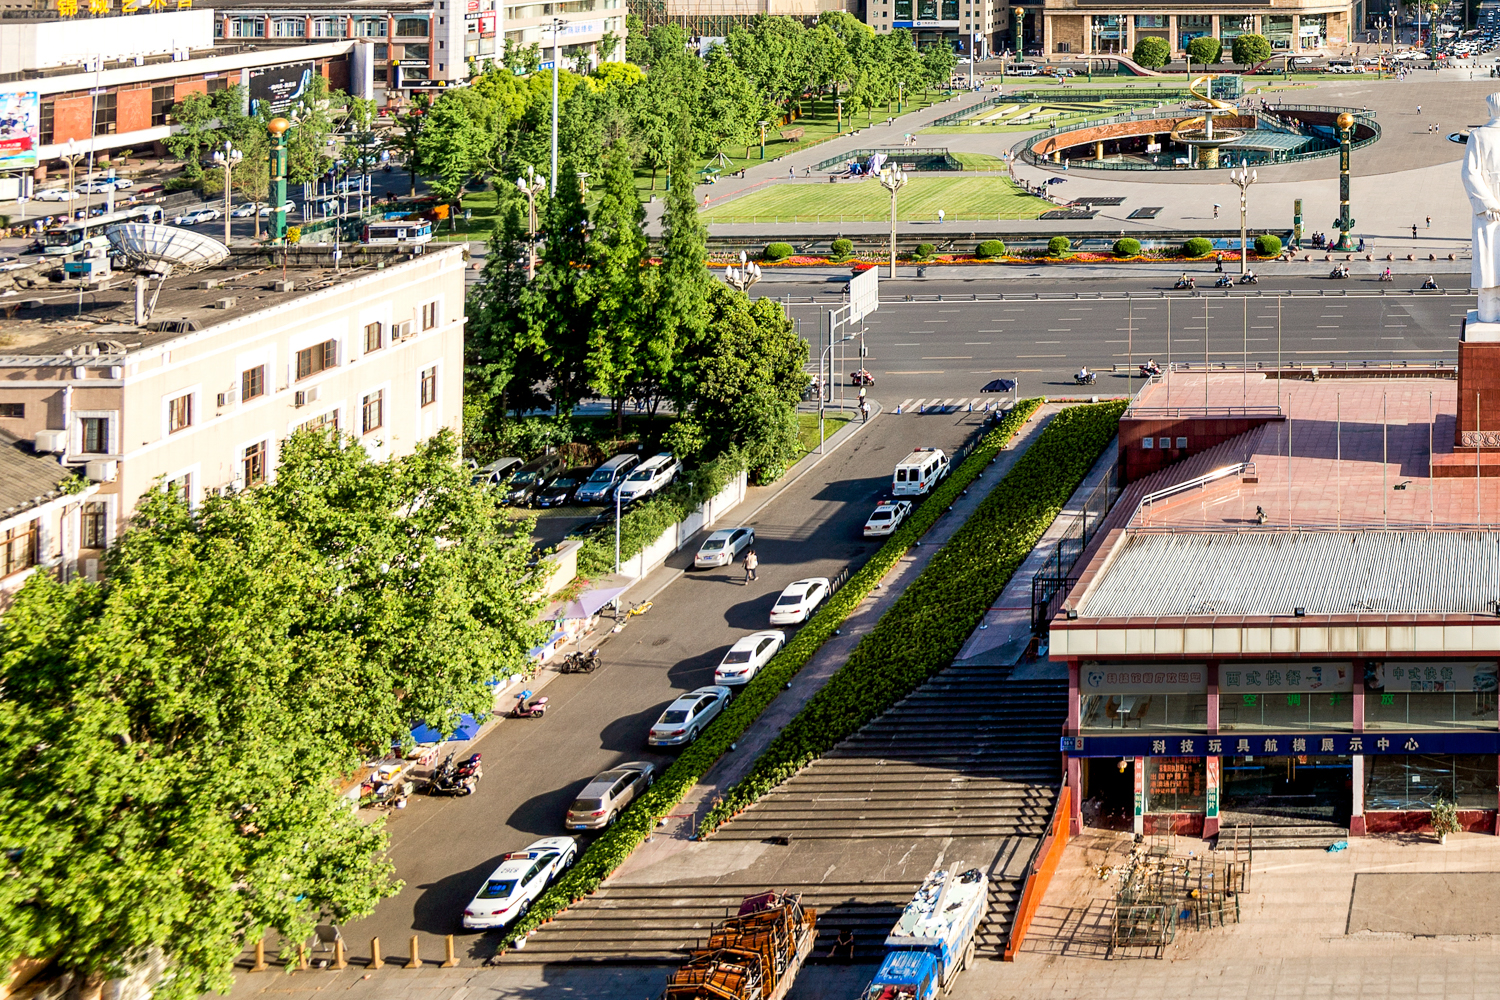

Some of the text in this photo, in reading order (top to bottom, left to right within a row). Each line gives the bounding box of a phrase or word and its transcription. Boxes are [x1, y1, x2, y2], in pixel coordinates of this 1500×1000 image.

[1226, 670, 1301, 687] 西式快餐
[1393, 666, 1453, 680] 中式快餐
[1076, 739, 1083, 748] 3
[1152, 737, 1420, 754] 科技玩具航模展示中心
